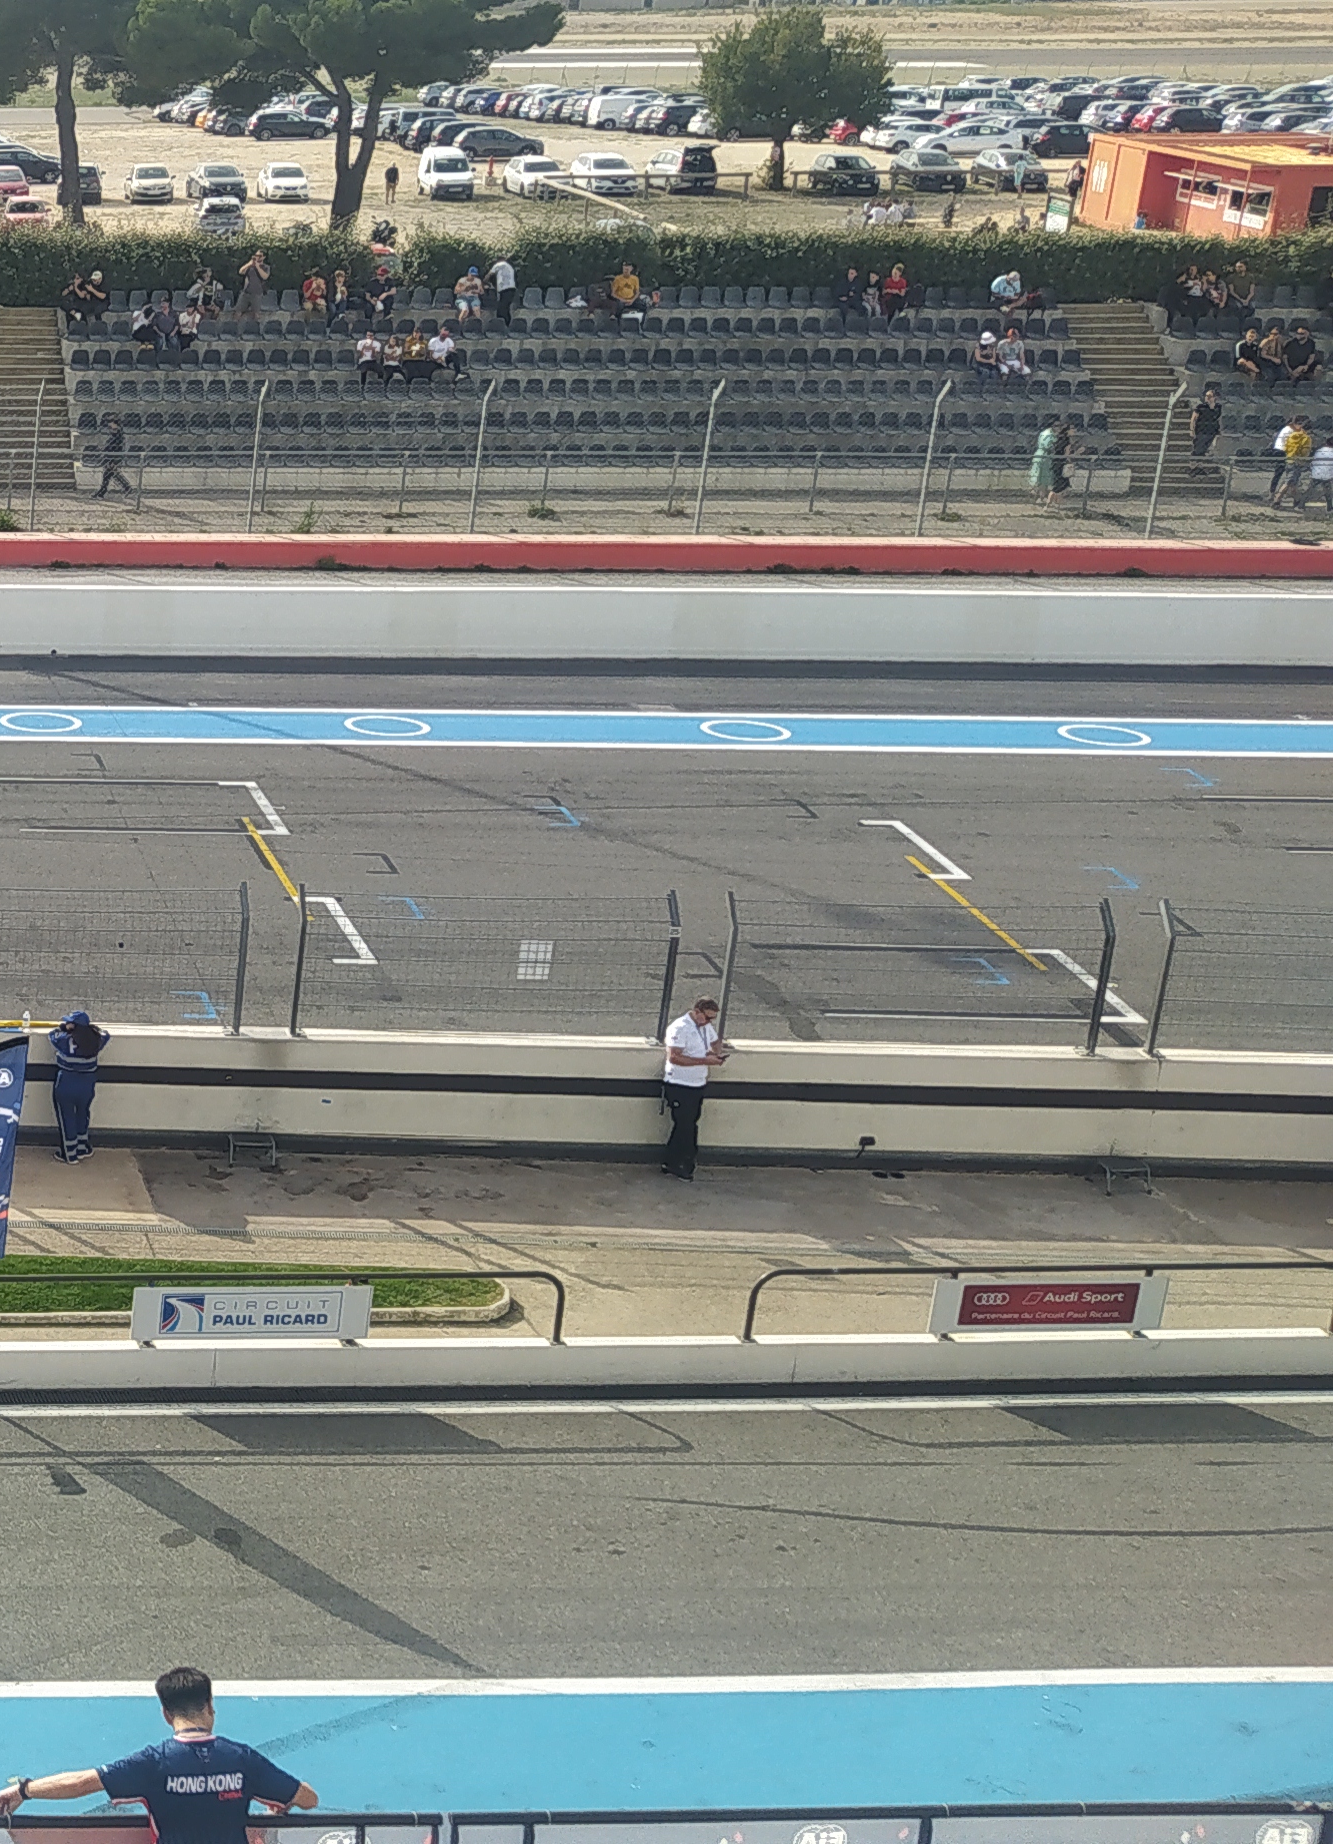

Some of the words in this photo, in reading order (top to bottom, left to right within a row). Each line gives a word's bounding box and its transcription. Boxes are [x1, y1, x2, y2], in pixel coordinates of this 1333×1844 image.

[1043, 1291, 1078, 1303] Audi
[1081, 1291, 1125, 1304] Sport
[213, 1299, 330, 1311] CIRCUIT
[212, 1314, 256, 1326] PAUL
[263, 1313, 328, 1325] RICARD
[166, 1774, 205, 1793] HONG
[207, 1772, 244, 1792] KONG
